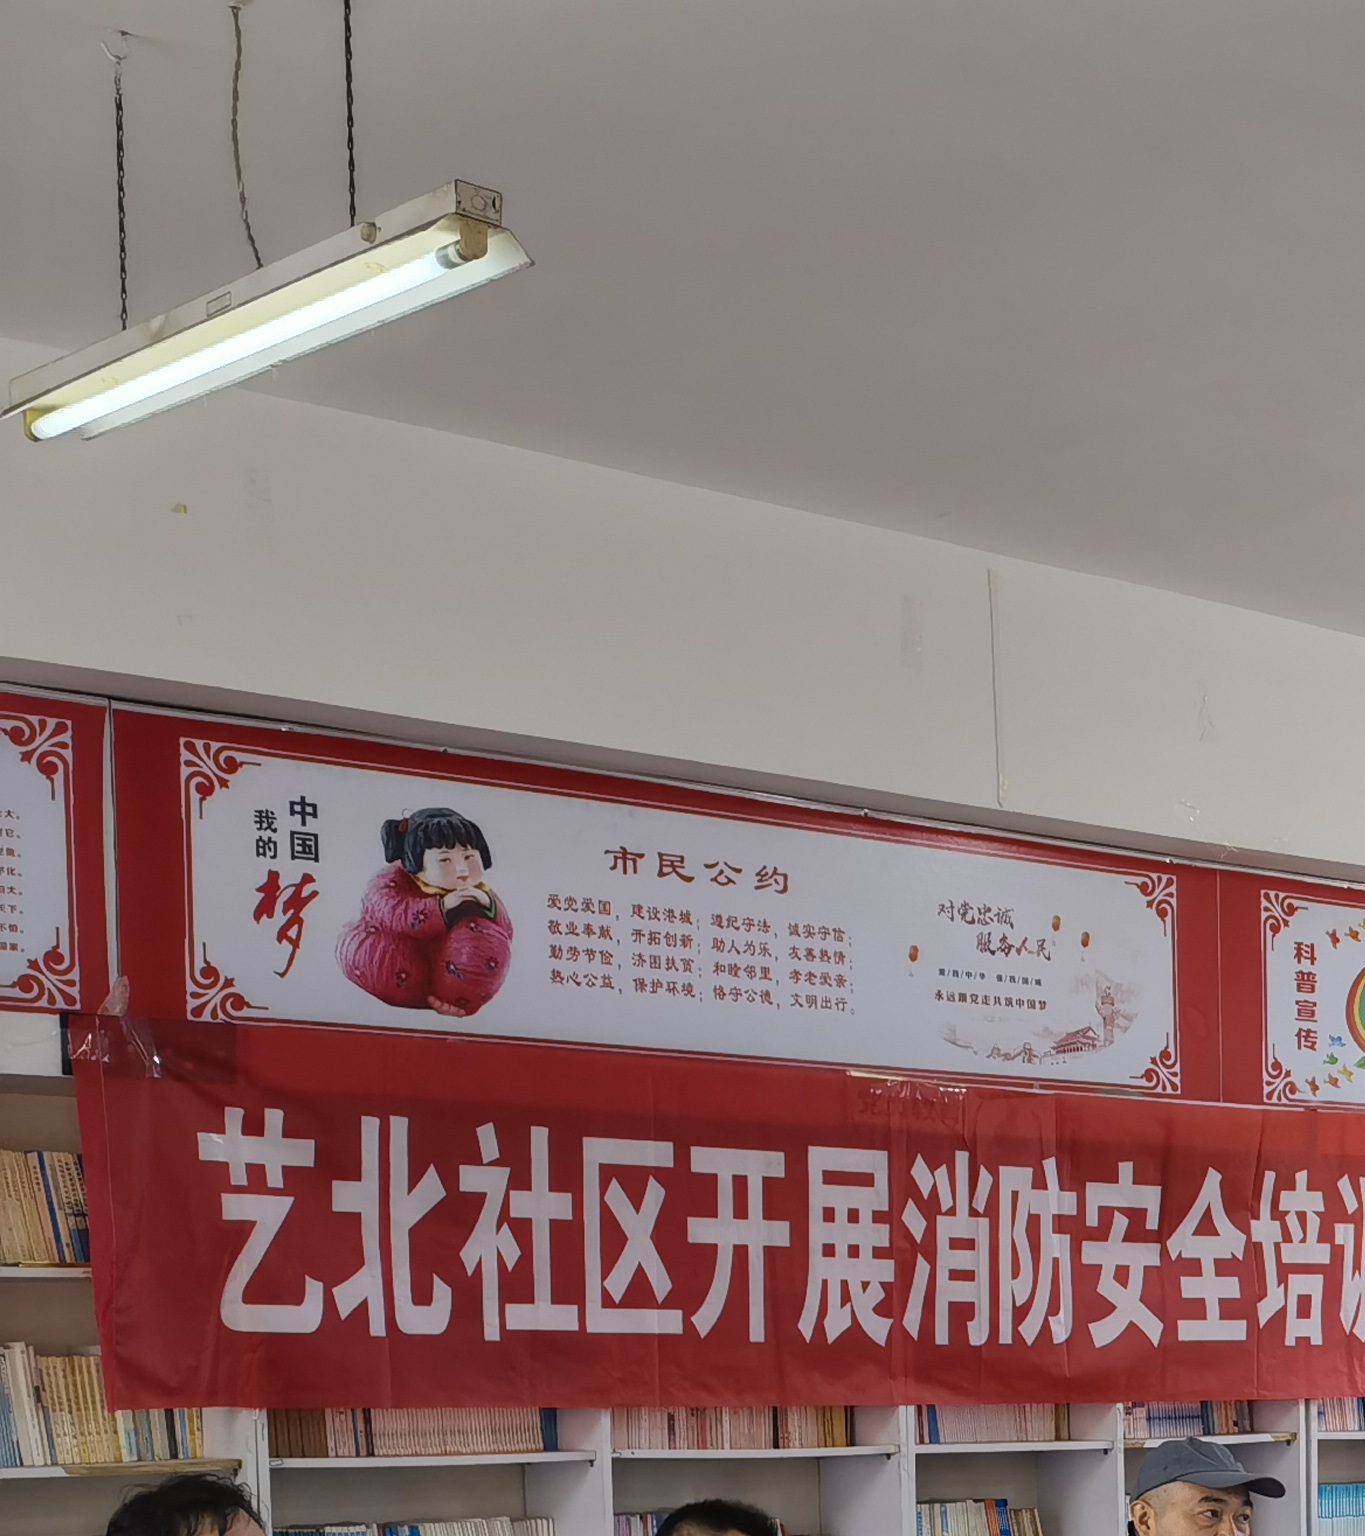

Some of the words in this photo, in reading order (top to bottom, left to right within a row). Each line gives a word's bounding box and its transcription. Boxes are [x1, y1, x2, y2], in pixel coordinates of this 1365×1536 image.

[254, 807, 278, 860] 我的
[288, 795, 320, 863] 中国
[604, 846, 789, 894] 市民公约
[253, 870, 319, 978] 梦
[937, 899, 1015, 929] 对党忠诚
[975, 932, 1052, 961] 服务人民
[1293, 941, 1318, 1051] 科普宣传
